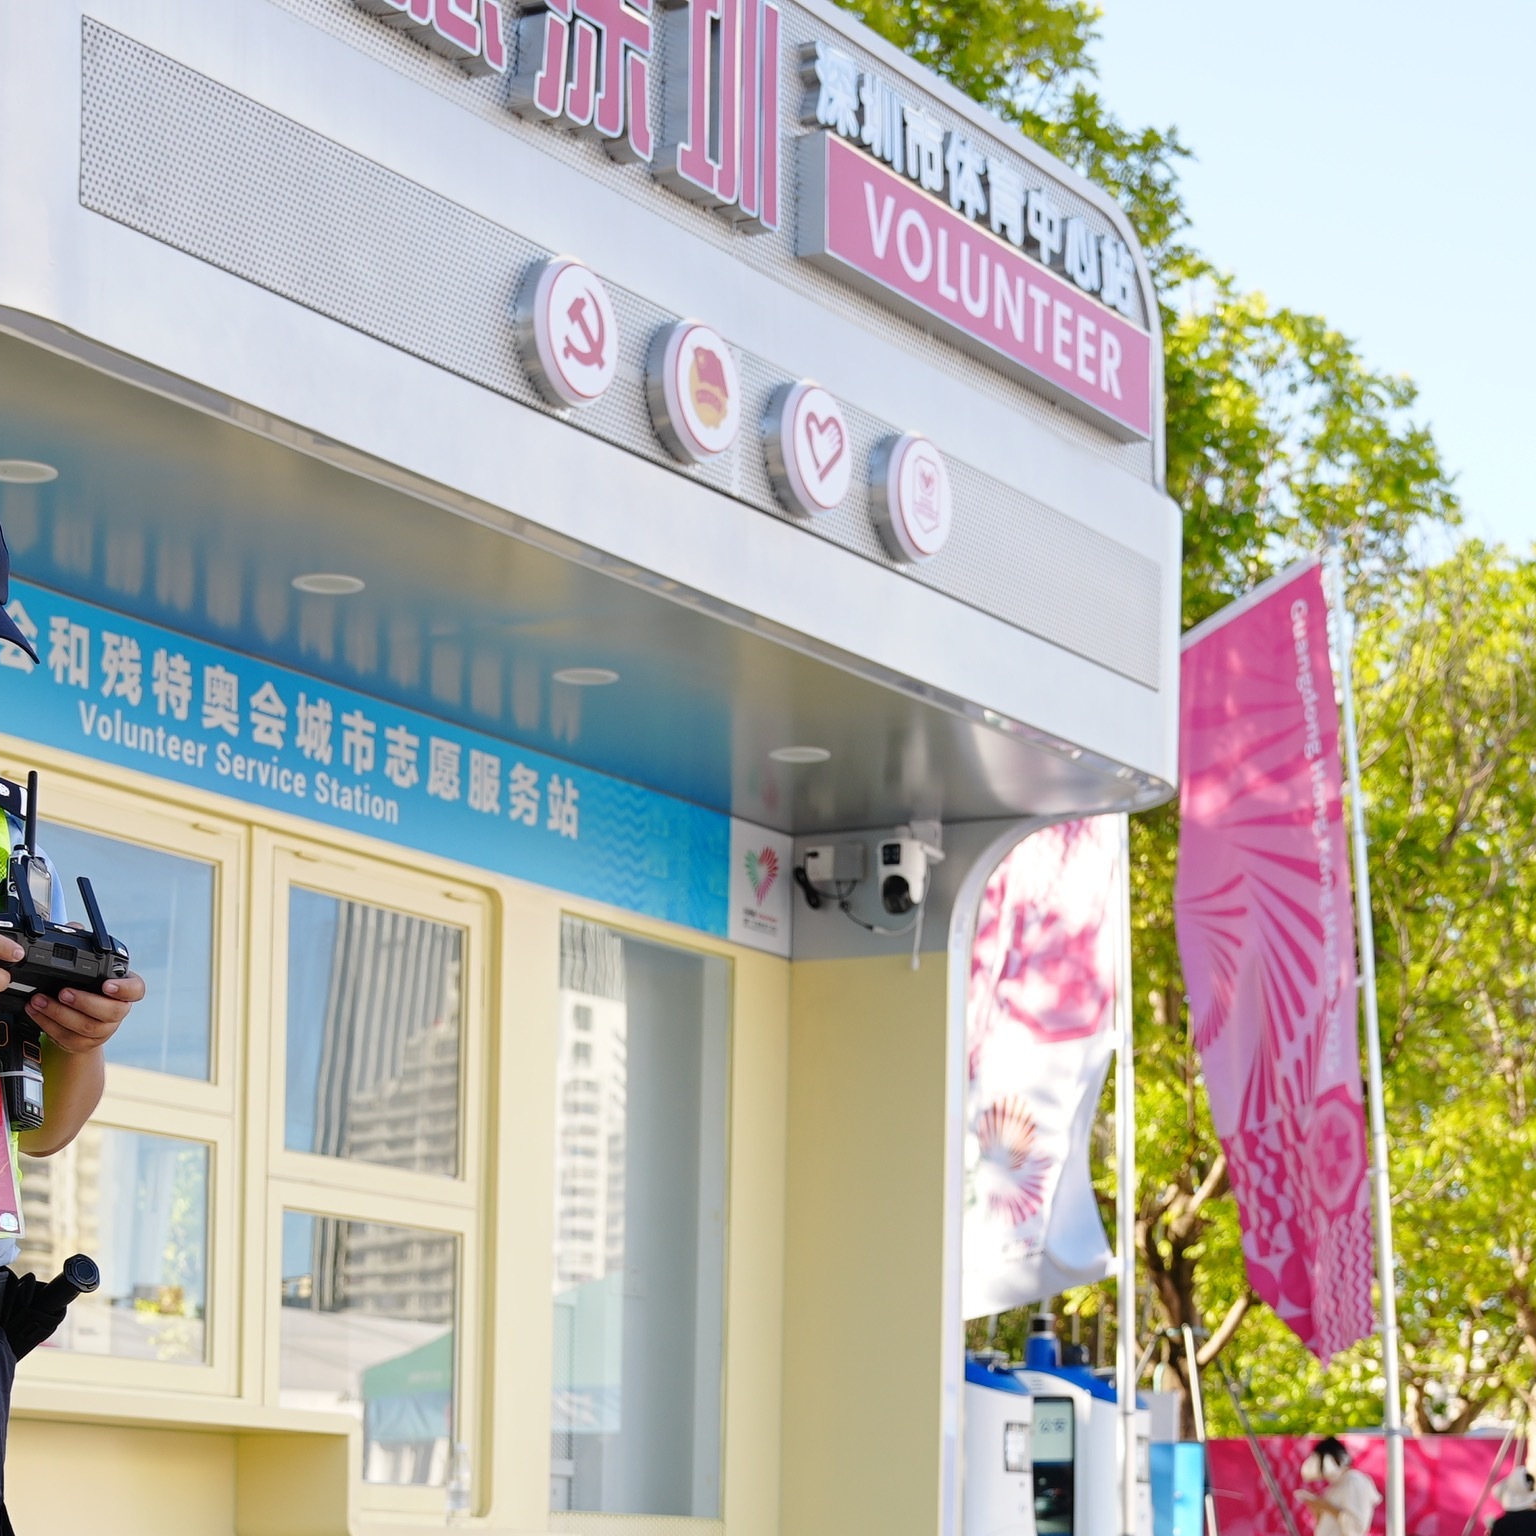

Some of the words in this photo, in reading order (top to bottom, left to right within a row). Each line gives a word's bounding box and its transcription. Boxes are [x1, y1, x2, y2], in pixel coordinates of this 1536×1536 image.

[813, 39, 1136, 318] 深圳市体育中心站
[863, 181, 1123, 401] VOLUNTEER
[1288, 597, 1325, 760] Guangdong
[77, 699, 207, 769] Volunteer
[215, 741, 307, 797] Service
[313, 771, 400, 826] Station
[1309, 759, 1331, 828] Hong
[1315, 840, 1337, 908] Kong
[1039, 1417, 1067, 1434] 公安
